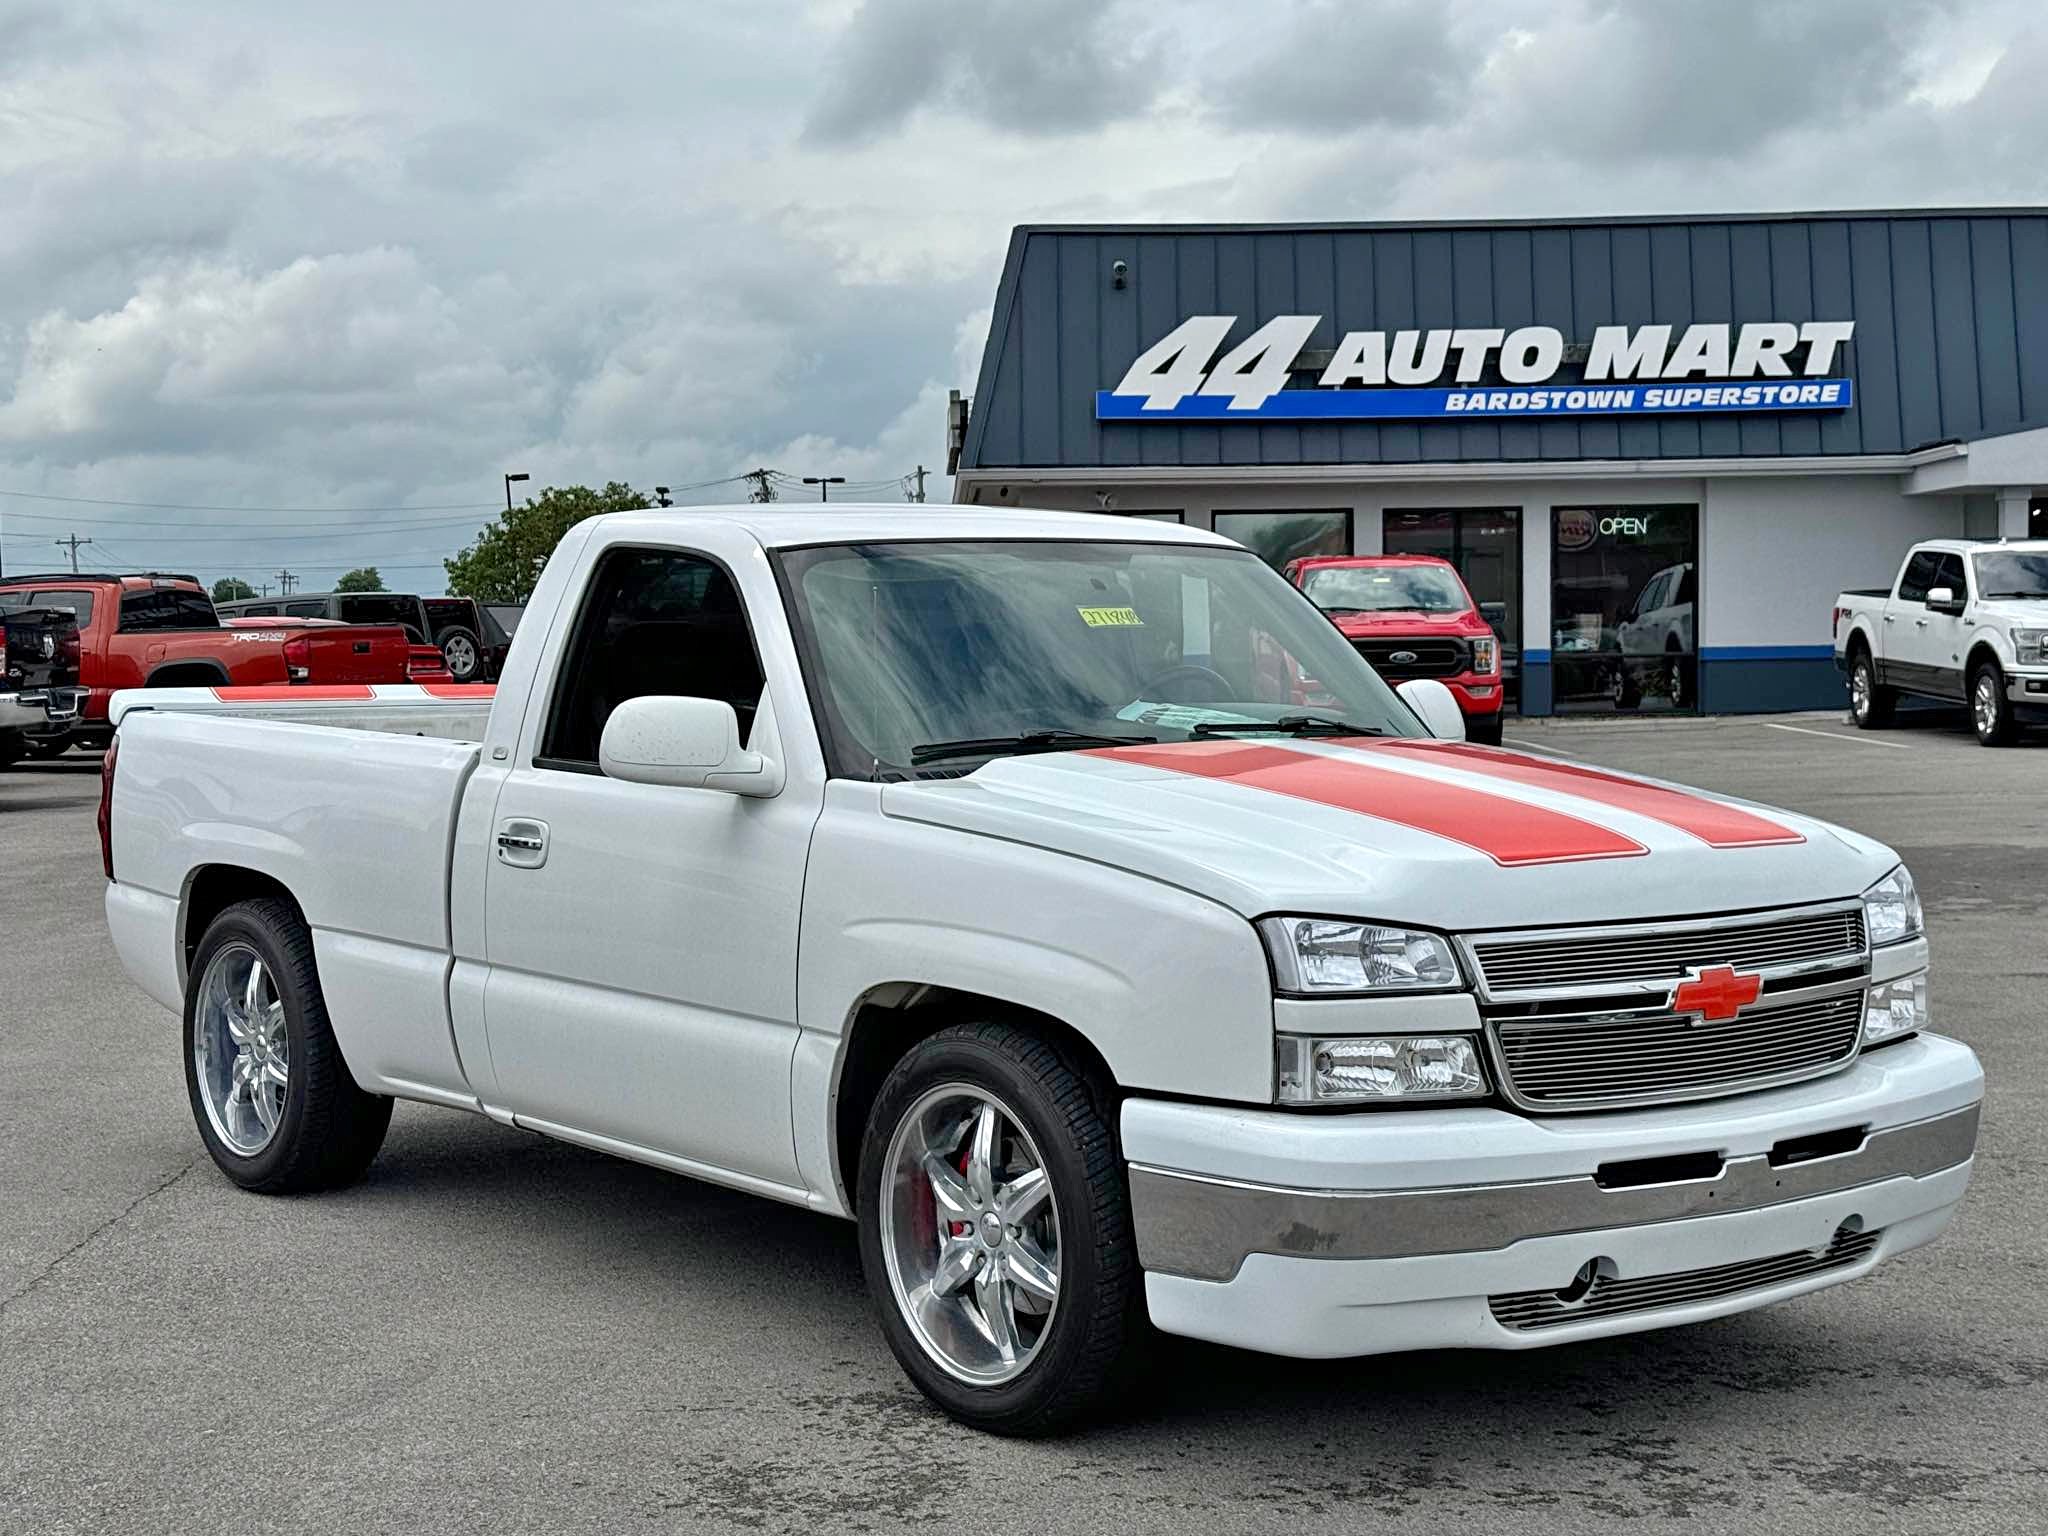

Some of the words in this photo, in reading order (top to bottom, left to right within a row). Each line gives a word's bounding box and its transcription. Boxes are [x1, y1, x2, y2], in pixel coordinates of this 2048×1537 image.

[1112, 315, 1323, 410] 44
[1317, 326, 1564, 385] AUTO
[1583, 321, 1855, 380] MART
[1445, 390, 1635, 411] BARDSTOWN
[1643, 384, 1841, 408] SUPERSTORE
[1600, 518, 1647, 534] OPEN
